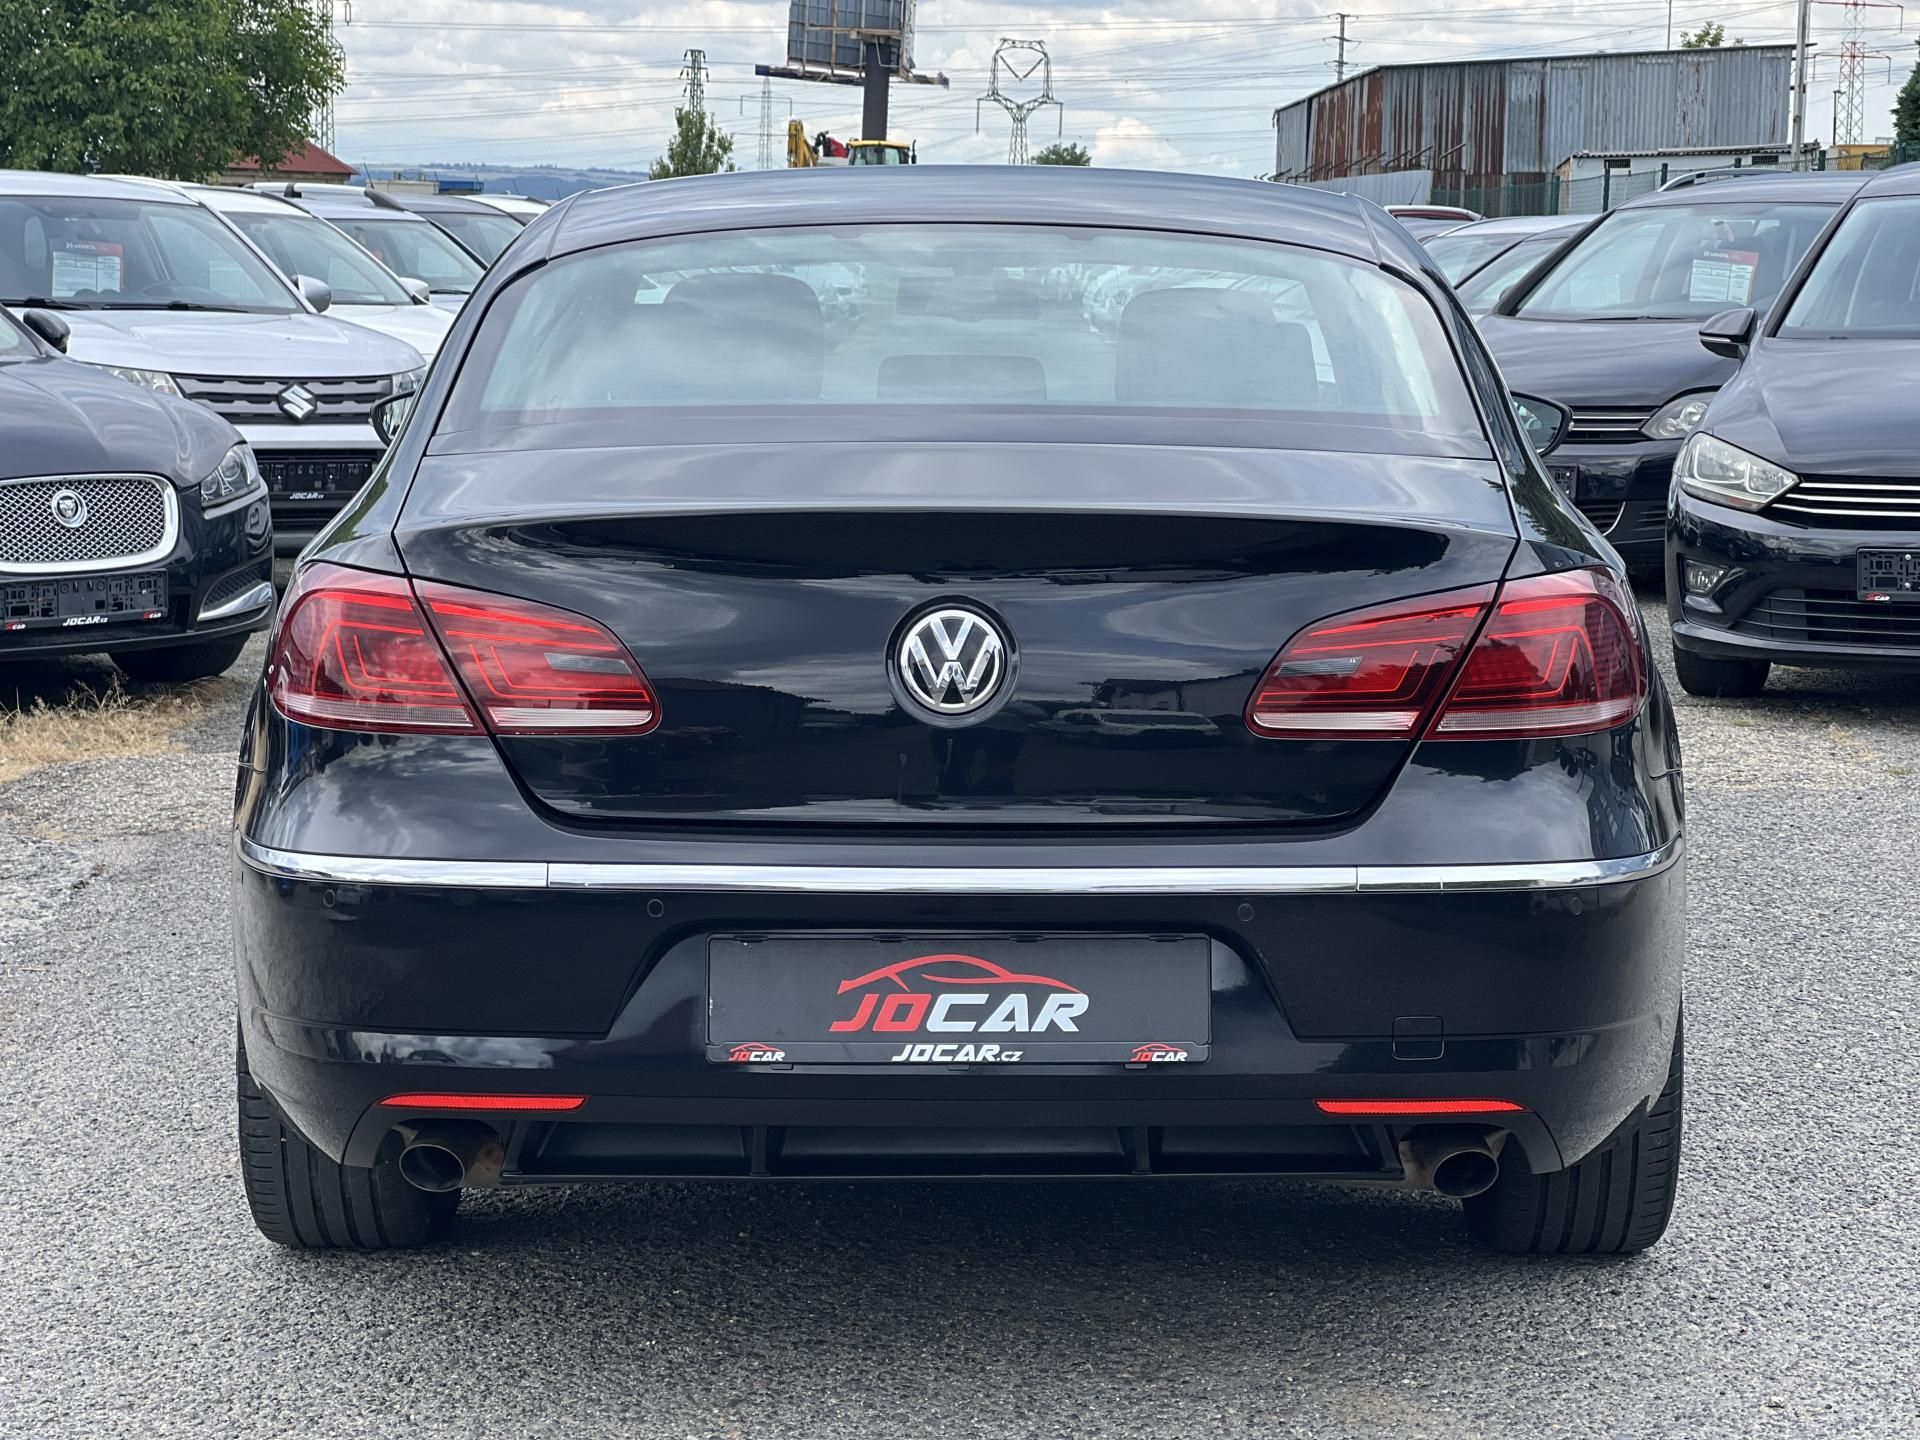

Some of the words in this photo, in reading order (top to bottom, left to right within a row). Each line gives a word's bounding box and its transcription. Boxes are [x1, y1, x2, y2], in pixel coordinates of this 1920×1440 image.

[829, 993, 1090, 1032] JOCAR
[728, 1049, 785, 1062] JOCAR
[1130, 1049, 1188, 1062] JOCAR
